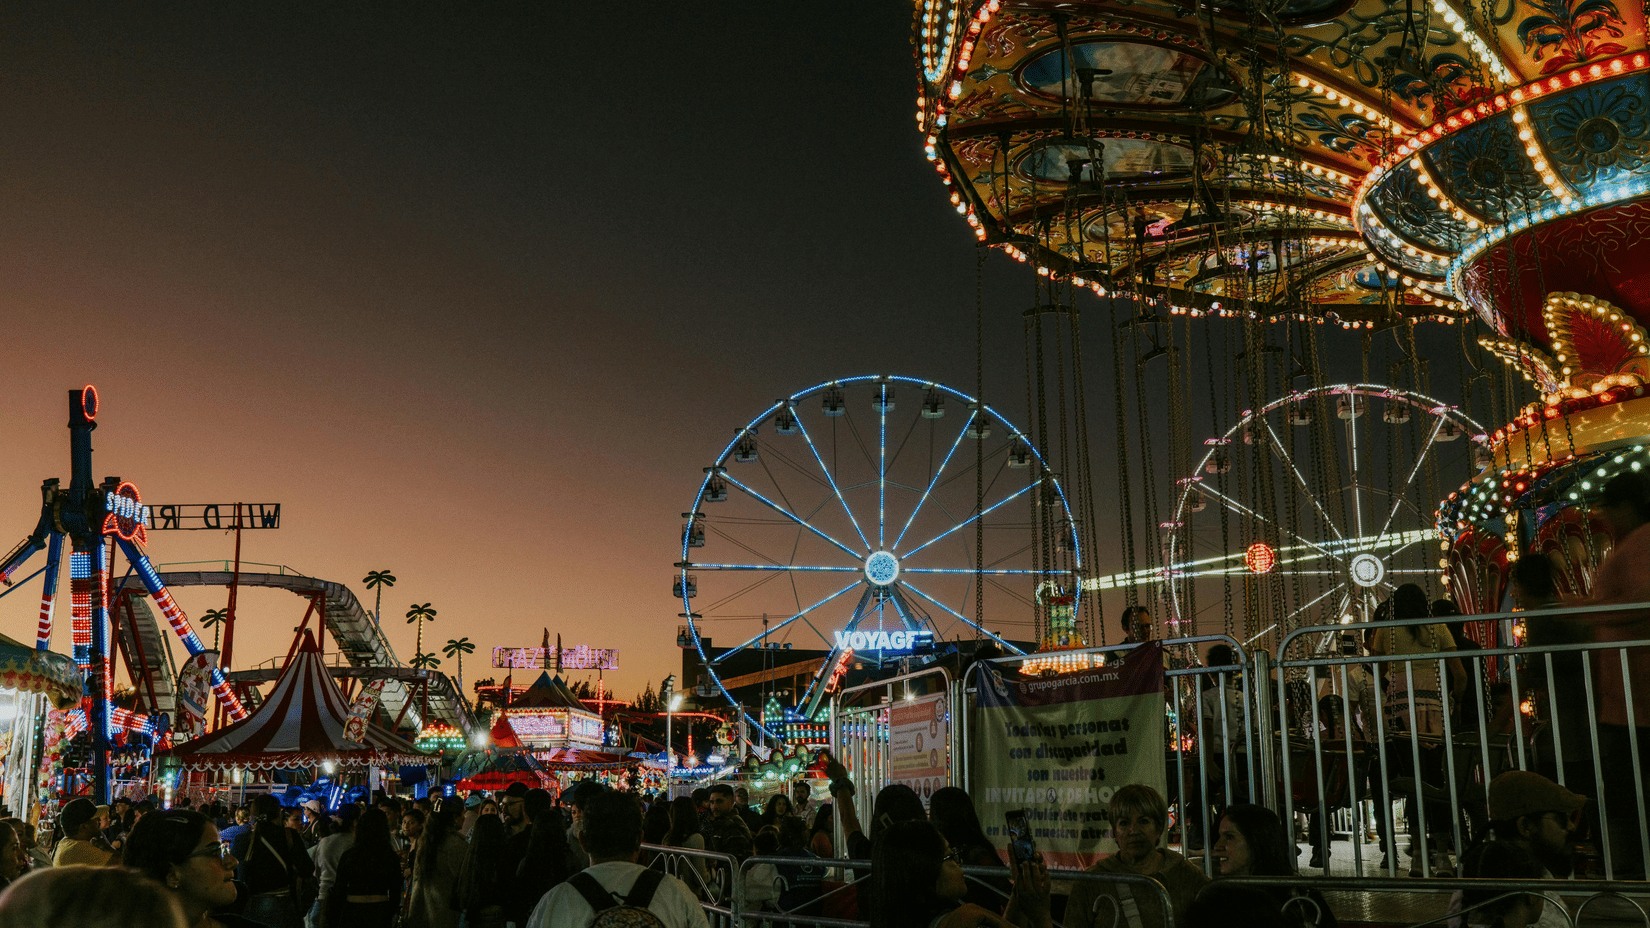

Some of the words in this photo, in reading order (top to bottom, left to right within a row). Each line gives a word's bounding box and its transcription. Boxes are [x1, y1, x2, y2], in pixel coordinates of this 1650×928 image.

[106, 491, 150, 526] SPIDER
[561, 645, 620, 670] MOUSE
[1058, 718, 1130, 739] personas
[1009, 747, 1032, 759] con
[1035, 737, 1128, 761] discapacidad
[1027, 768, 1049, 781] son
[1052, 766, 1106, 782] nuestros
[1067, 787, 1082, 804] DE
